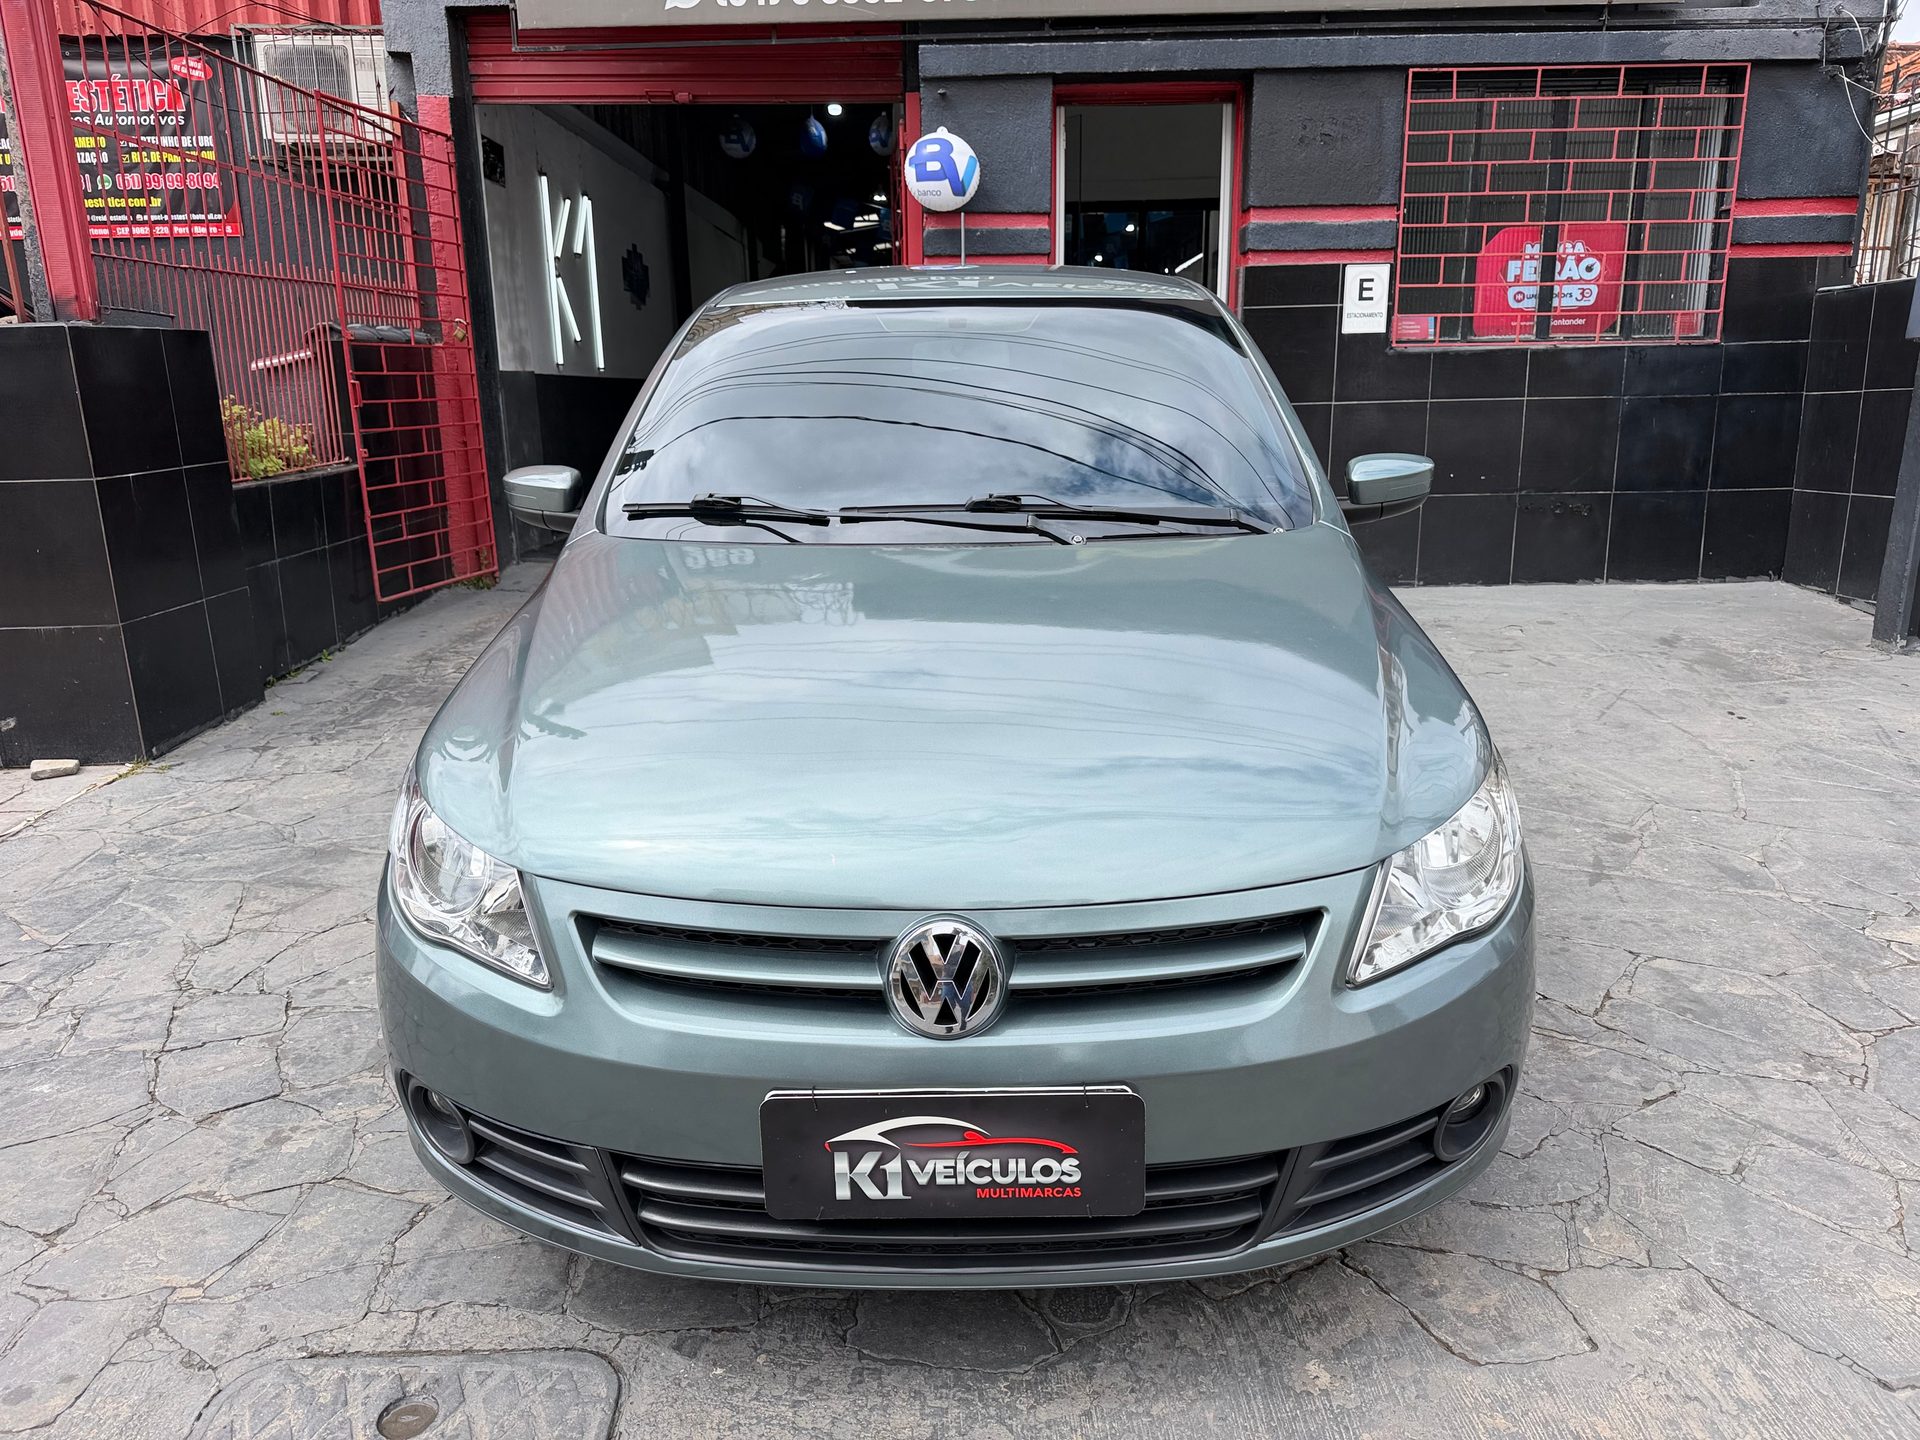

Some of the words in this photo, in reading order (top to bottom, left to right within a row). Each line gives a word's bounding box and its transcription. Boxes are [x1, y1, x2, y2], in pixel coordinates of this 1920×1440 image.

[908, 137, 977, 197] BV
[917, 187, 942, 197] banco
[1524, 241, 1585, 258] MGA
[1507, 256, 1601, 282] FERÃO
[1358, 278, 1375, 301] E
[834, 1151, 911, 1200] K1
[907, 1151, 1082, 1185] VEÍCULOS
[976, 1187, 1082, 1199] MULTIMARCAS
